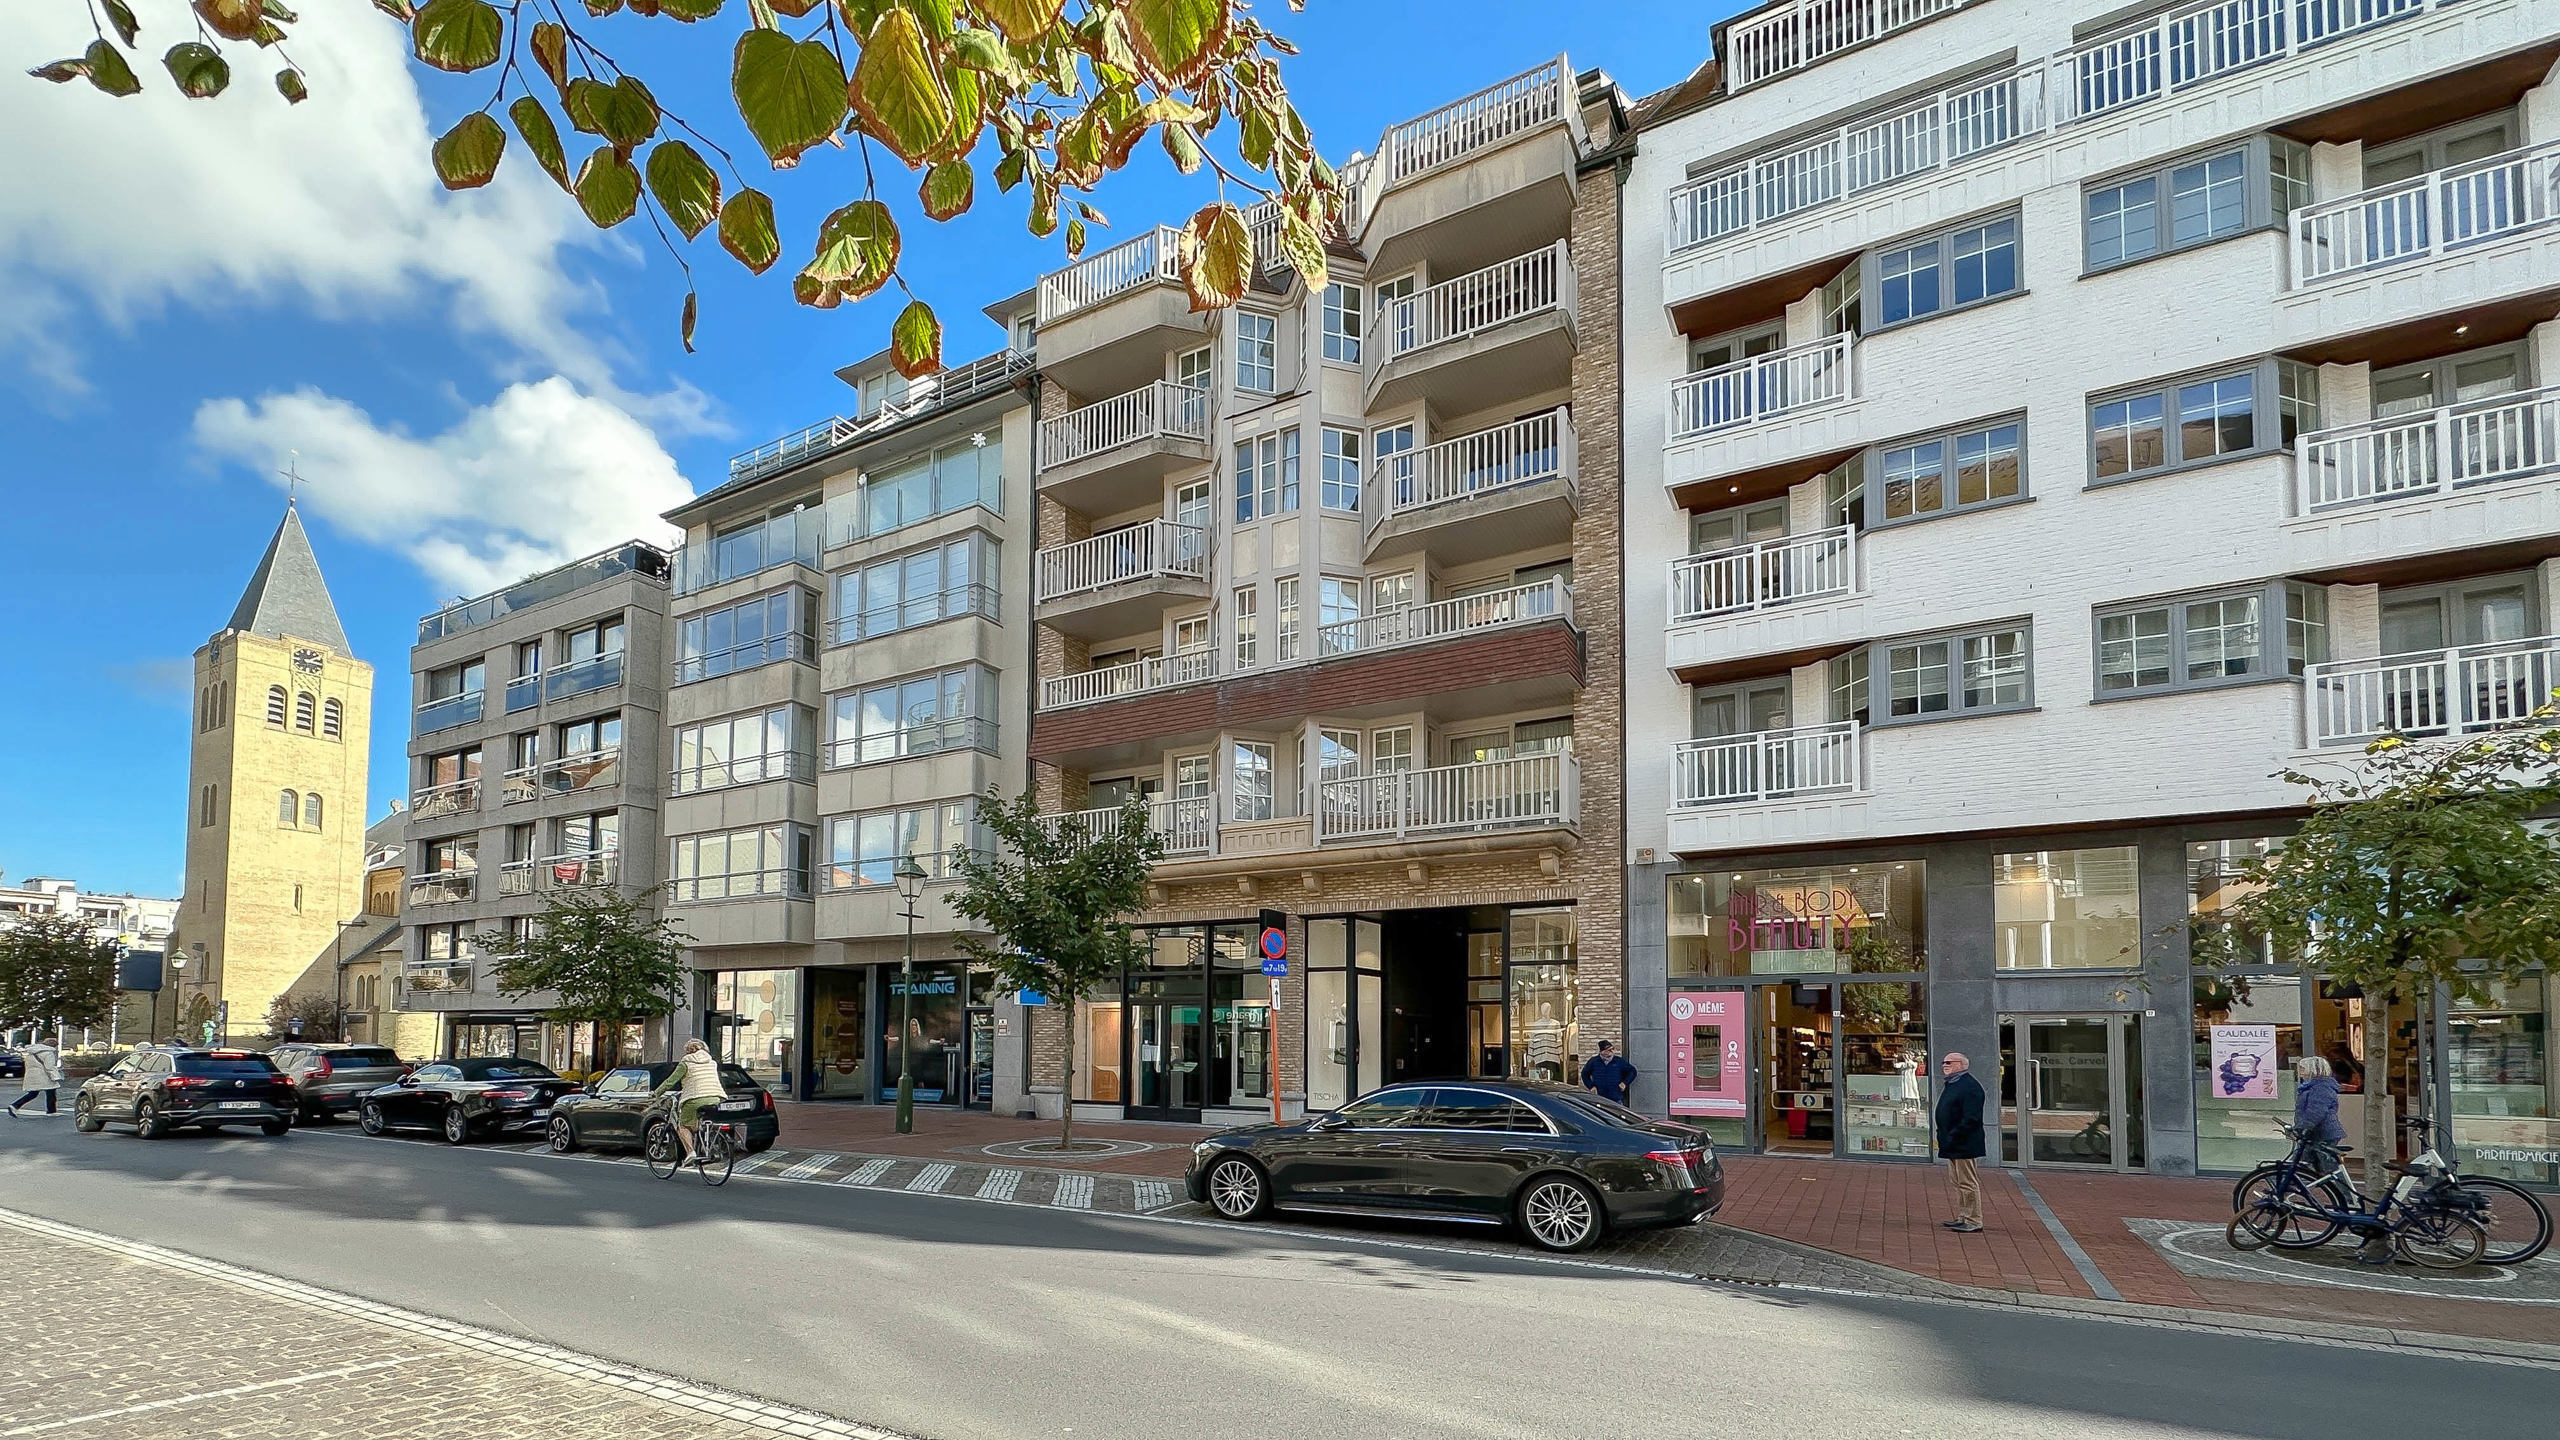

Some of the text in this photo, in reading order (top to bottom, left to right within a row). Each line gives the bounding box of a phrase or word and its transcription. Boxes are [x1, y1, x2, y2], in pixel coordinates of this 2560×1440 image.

[1772, 893, 1784, 913] &
[1795, 889, 1856, 913] BODY
[1728, 912, 1858, 952] BEAUTY
[1269, 963, 1273, 972] 7
[889, 982, 955, 995] TRAINING
[1697, 1001, 1725, 1013] MÊME
[2040, 1056, 2106, 1065] Res. Carvel
[1313, 1092, 1340, 1101] TISCHA
[2475, 1148, 2559, 1163] PARAFARMACIE
